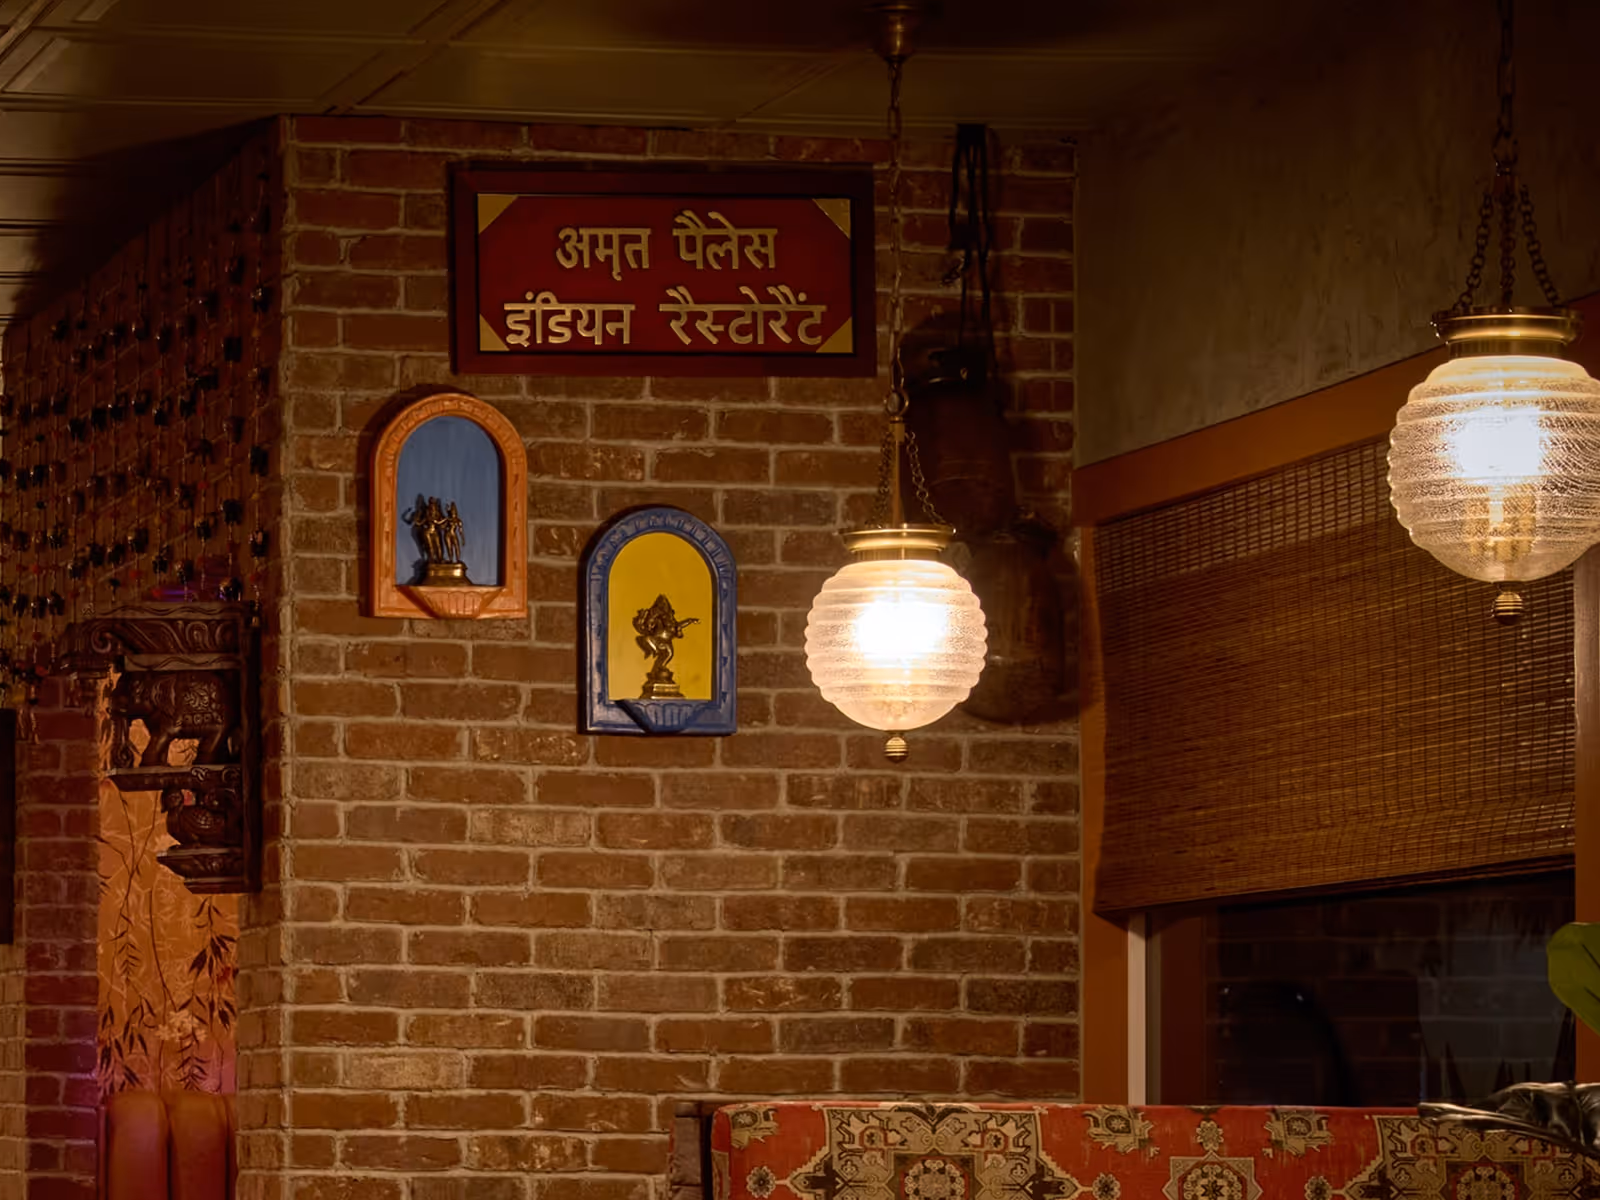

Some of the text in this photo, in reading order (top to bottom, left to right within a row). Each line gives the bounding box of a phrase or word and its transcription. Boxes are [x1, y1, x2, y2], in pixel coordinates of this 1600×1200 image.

[556, 210, 778, 281] अमृत पैलेस
[504, 291, 636, 348] इंडियन
